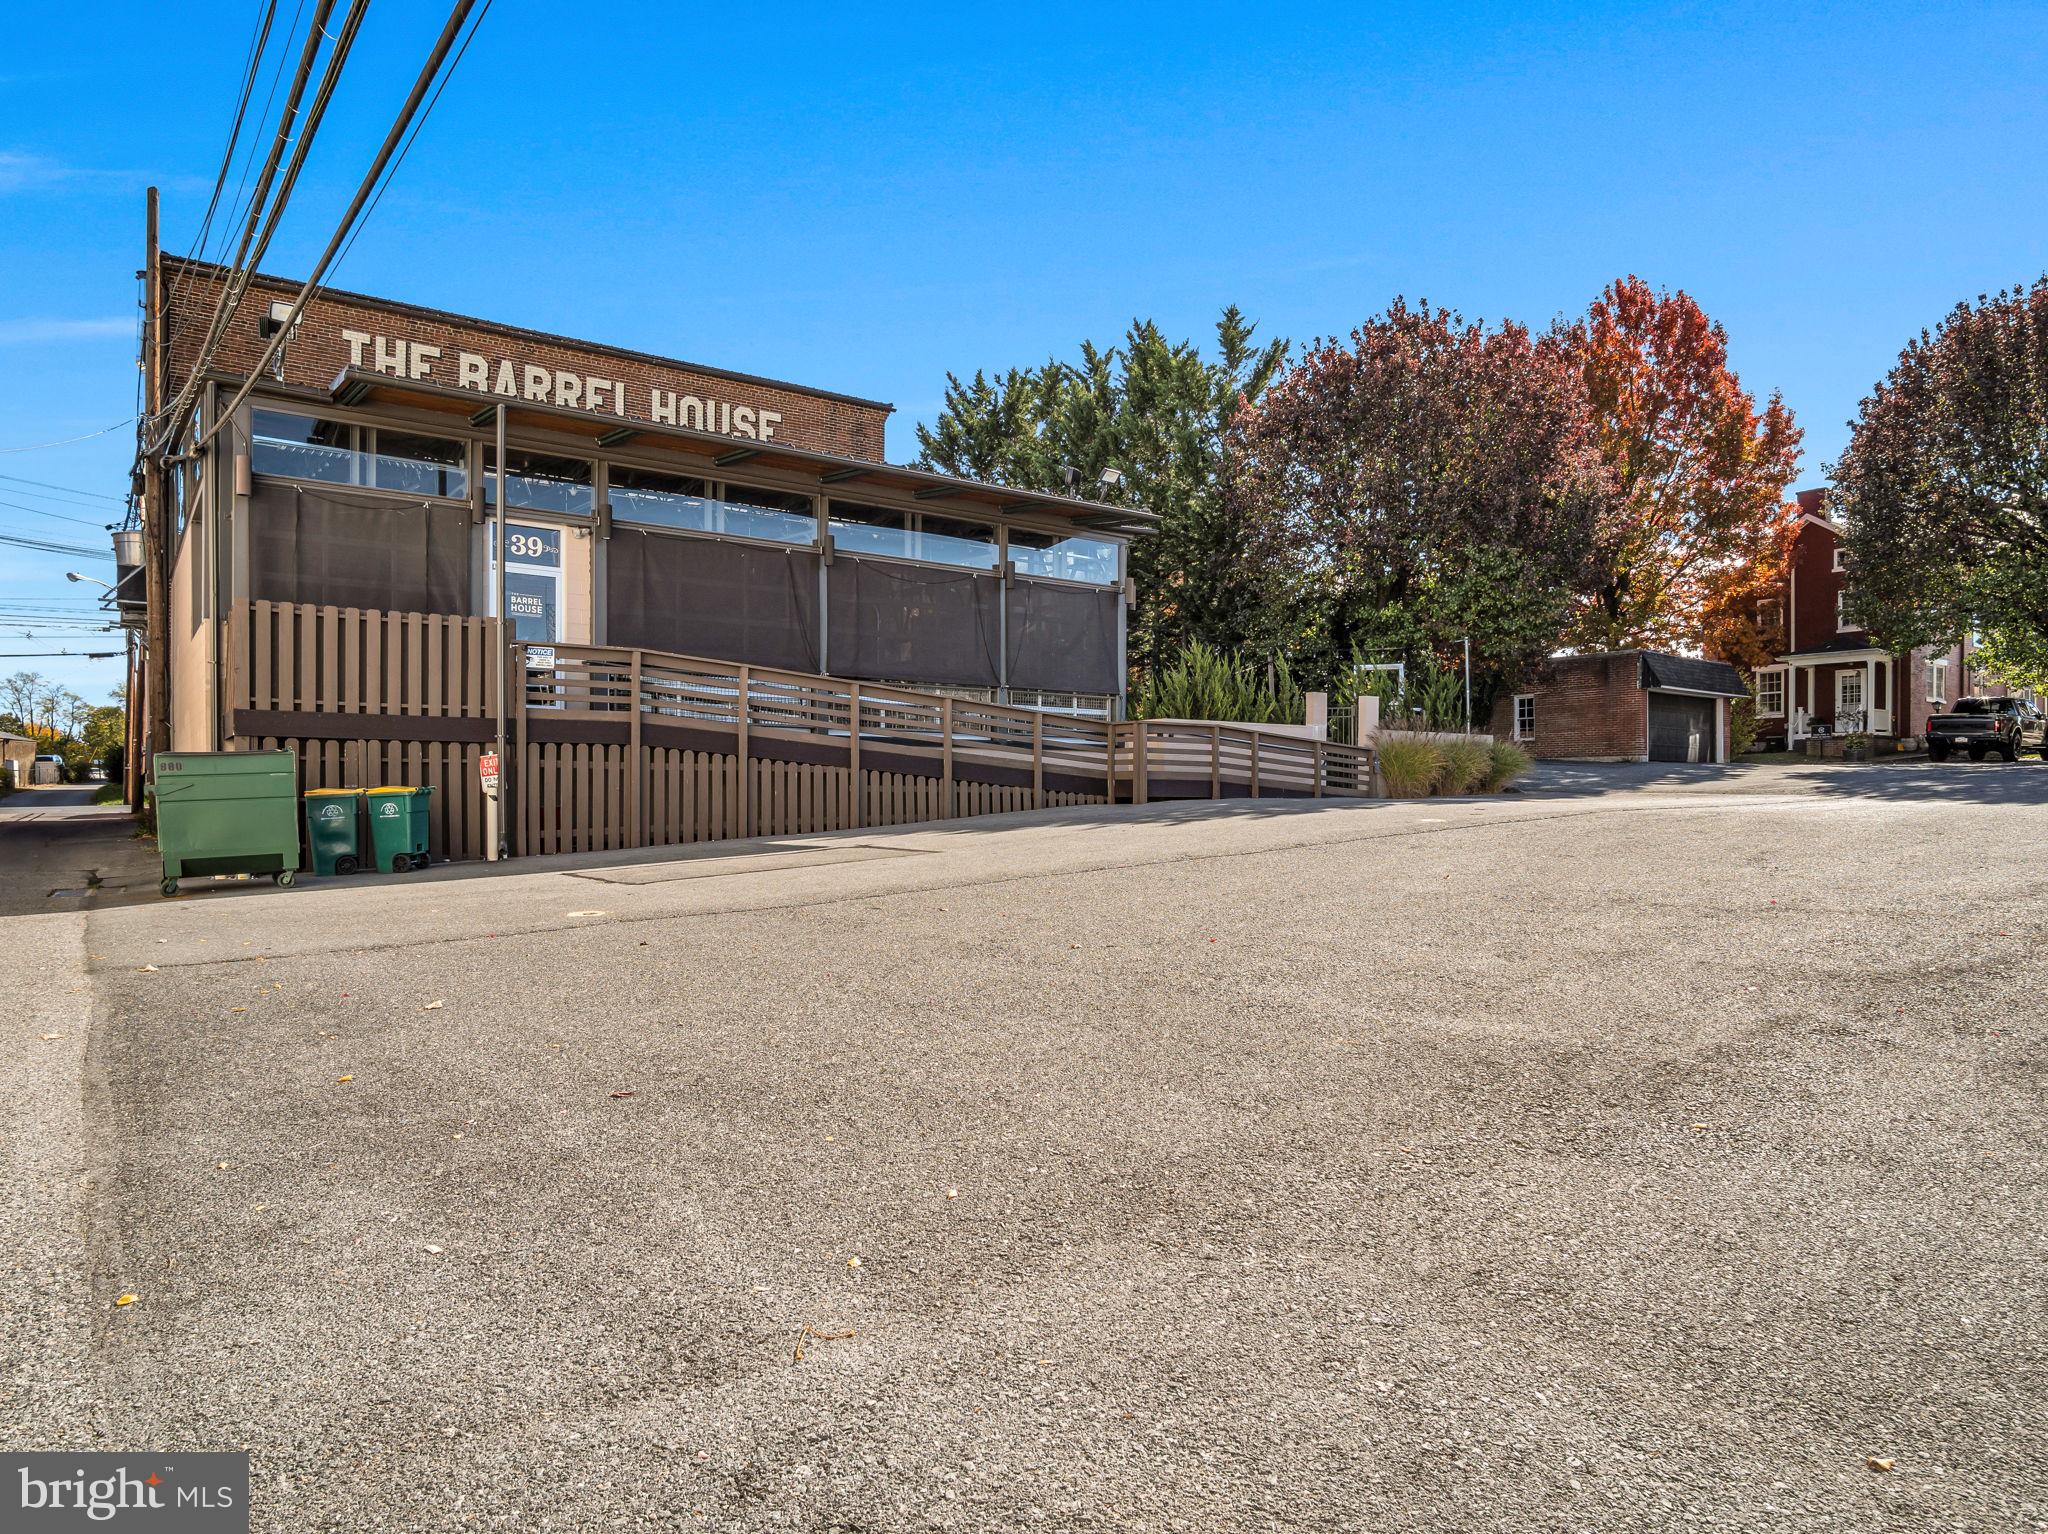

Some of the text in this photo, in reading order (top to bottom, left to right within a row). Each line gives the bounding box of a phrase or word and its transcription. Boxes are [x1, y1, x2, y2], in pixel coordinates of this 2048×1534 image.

[342, 329, 782, 441] THE BARREL HOUSE
[511, 534, 543, 557] 39
[511, 595, 542, 606] BARREL
[511, 603, 543, 614] HOUSE
[527, 648, 552, 656] NOTICE
[483, 766, 498, 775] ONL
